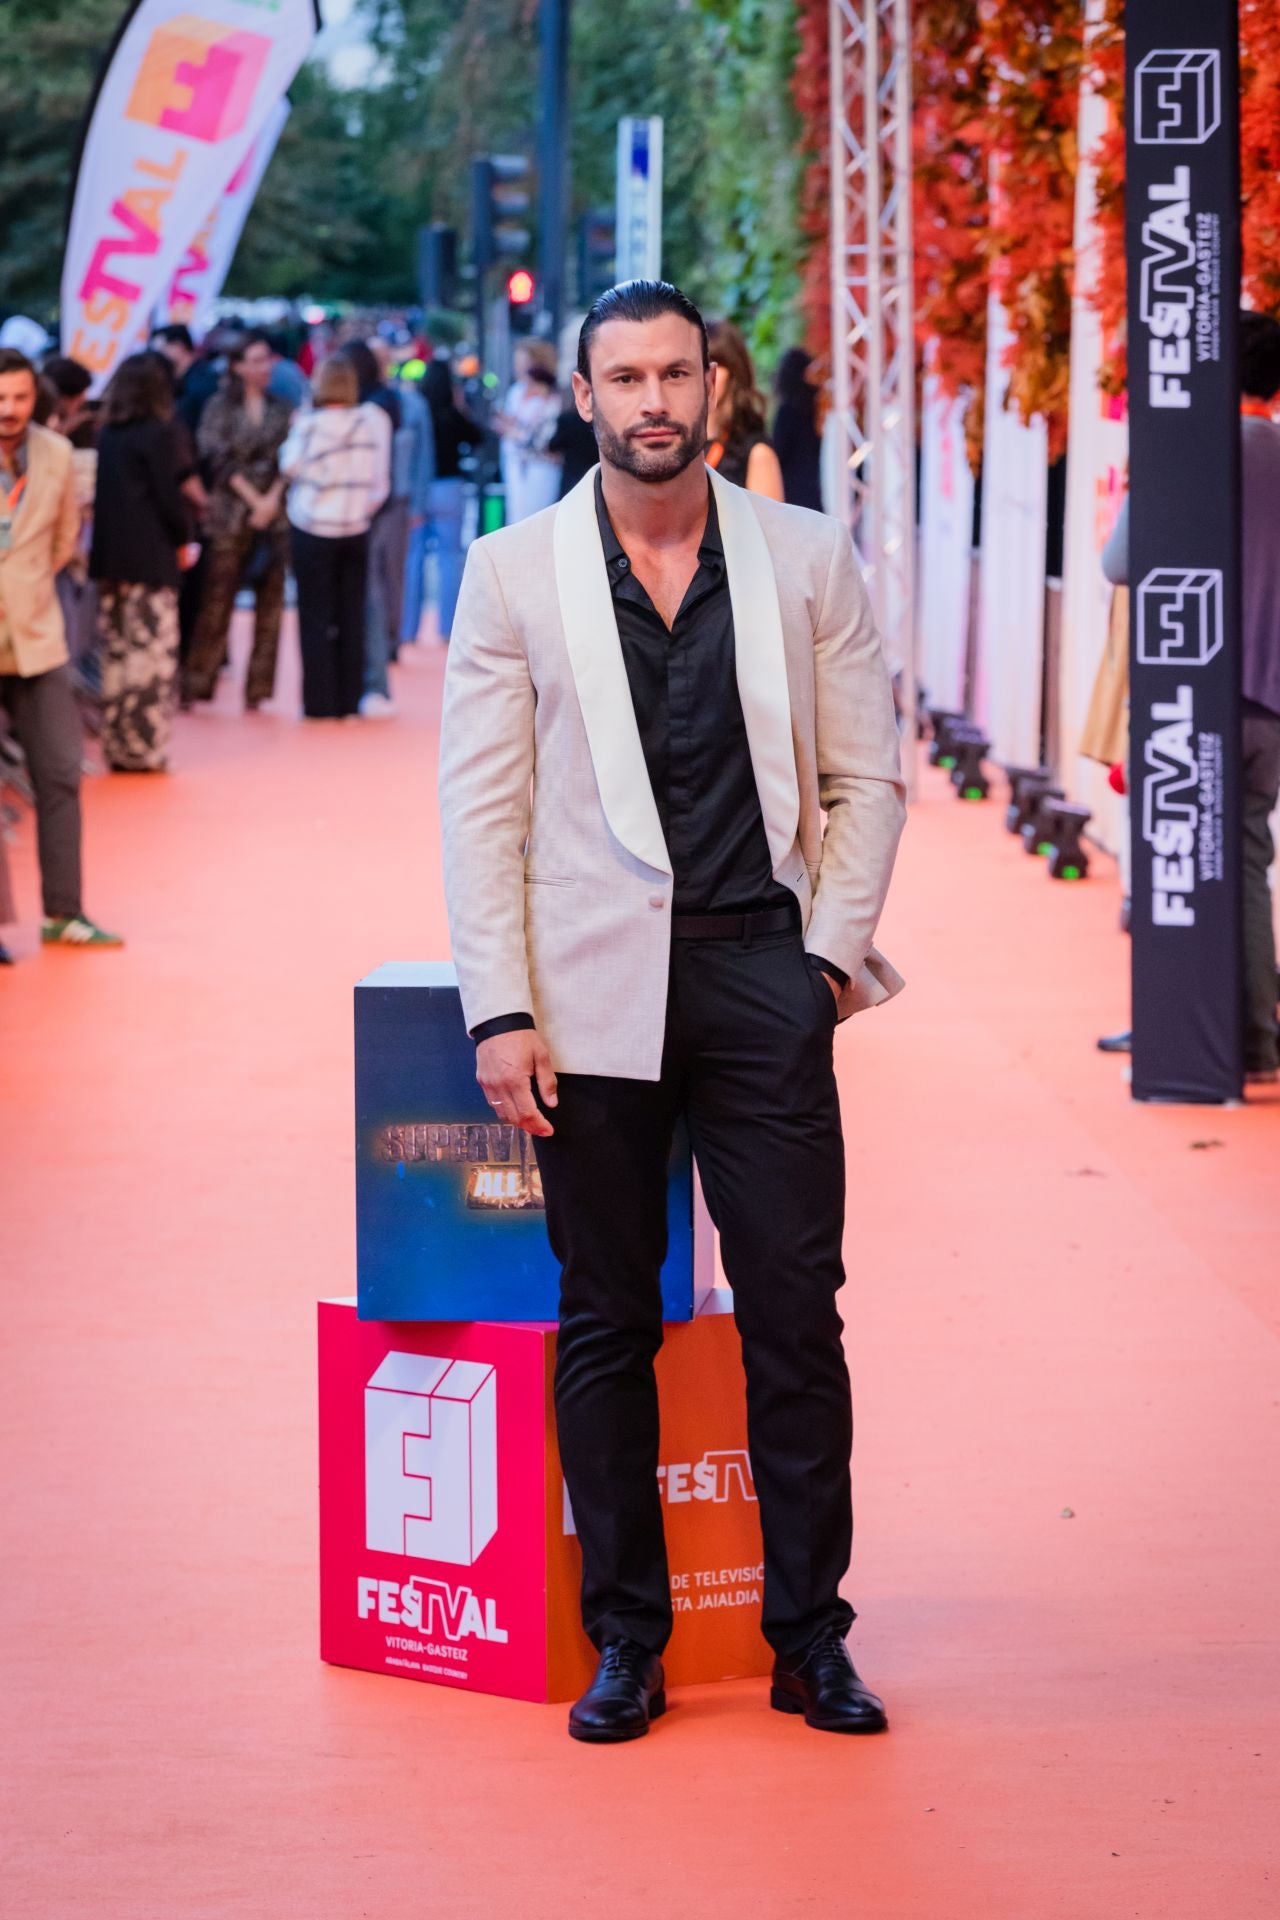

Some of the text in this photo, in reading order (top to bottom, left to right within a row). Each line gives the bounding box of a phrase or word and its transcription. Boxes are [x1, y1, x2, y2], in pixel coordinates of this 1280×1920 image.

[68, 147, 189, 374] ESTVAL
[1140, 165, 1196, 408] FESTVAL
[1196, 211, 1212, 363] VITORIA-GASTEIZ
[1142, 685, 1199, 926] FESTVAL
[473, 1171, 520, 1198] ALL
[357, 1574, 509, 1644] FESTVAL
[671, 1560, 765, 1590] DE TELEVISIÓ
[696, 1588, 760, 1610] JAIALDIA
[385, 1635, 469, 1672] VITORIA-GASTEIZ
